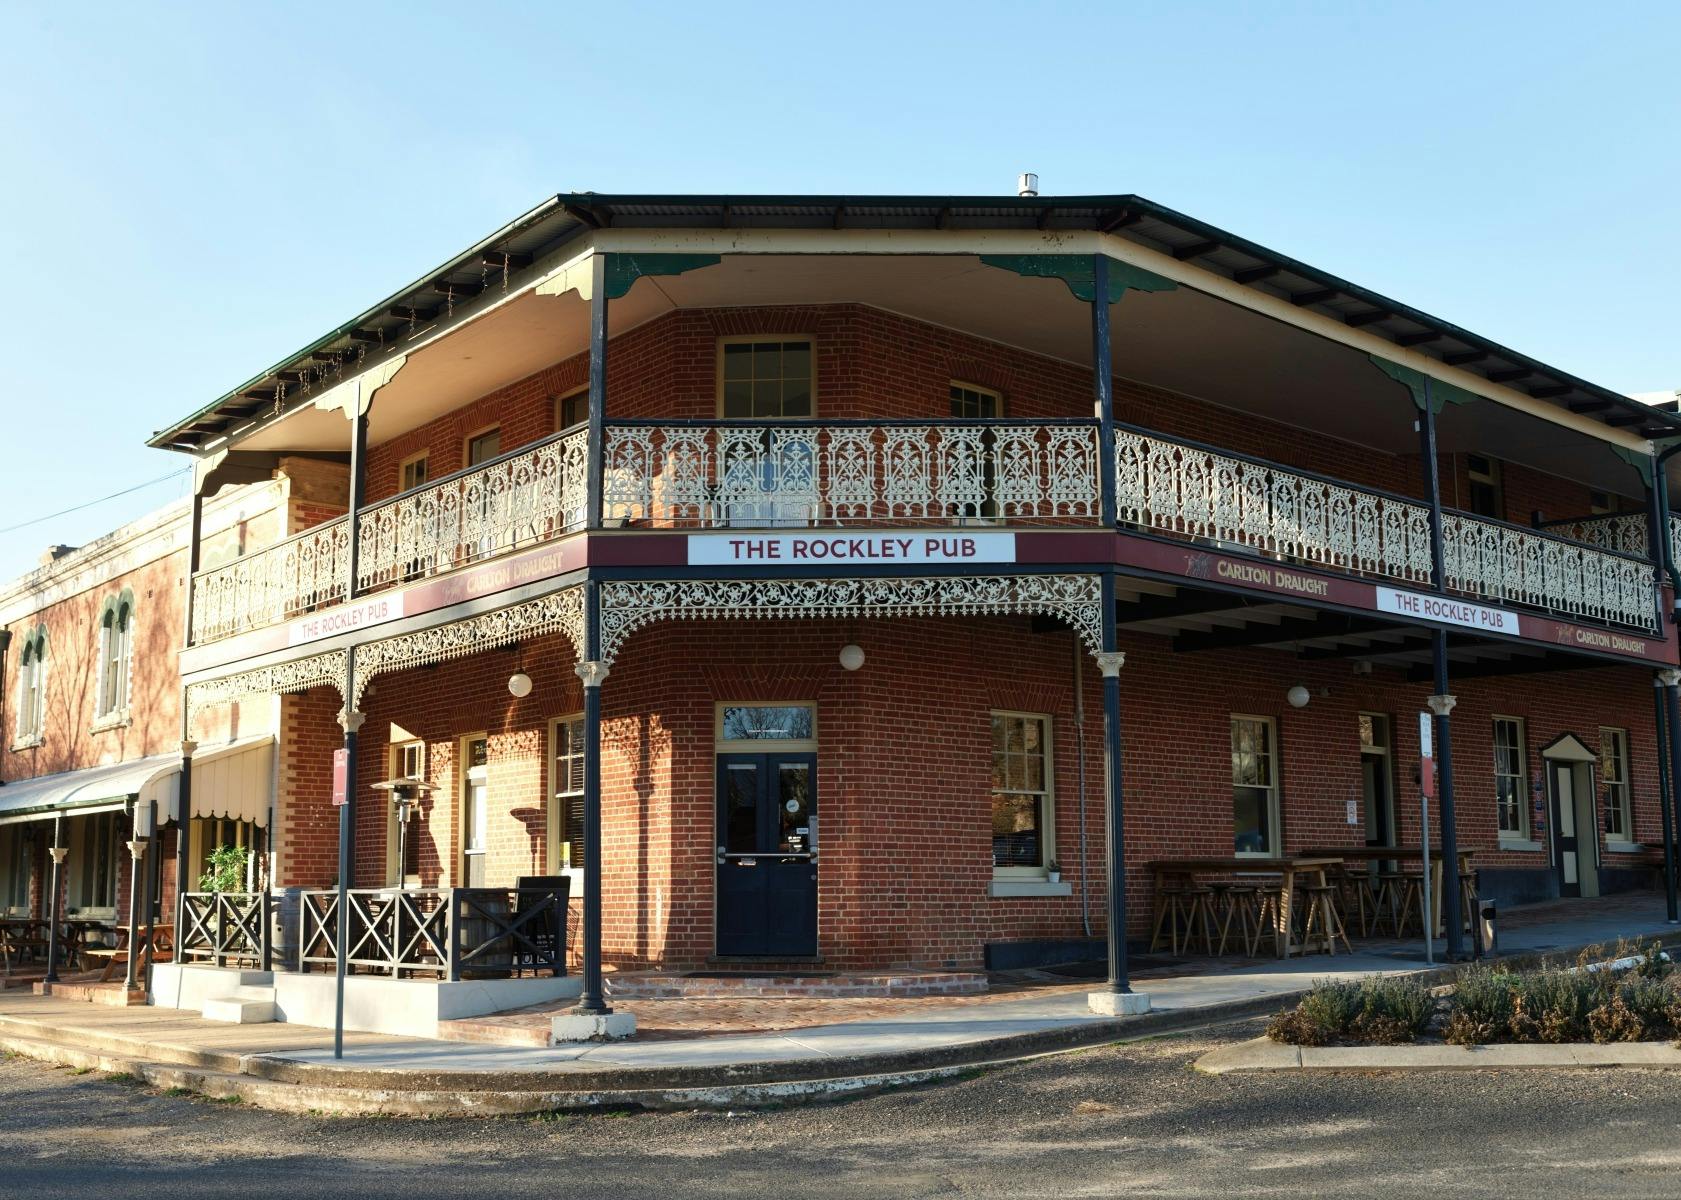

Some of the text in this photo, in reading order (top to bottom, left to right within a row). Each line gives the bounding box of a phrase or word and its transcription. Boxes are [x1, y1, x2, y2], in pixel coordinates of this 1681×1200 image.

[729, 538, 977, 559] THE ROCKLEY PUB
[466, 552, 564, 595] CARLTON DRAUGHT
[1217, 559, 1329, 596] CARLTON DRAUGHT
[302, 601, 388, 639] THE ROCKLEY PUB
[1394, 593, 1504, 628] THE ROCKLEY PUB
[1576, 628, 1646, 655] CARLTON DRAUGHT
